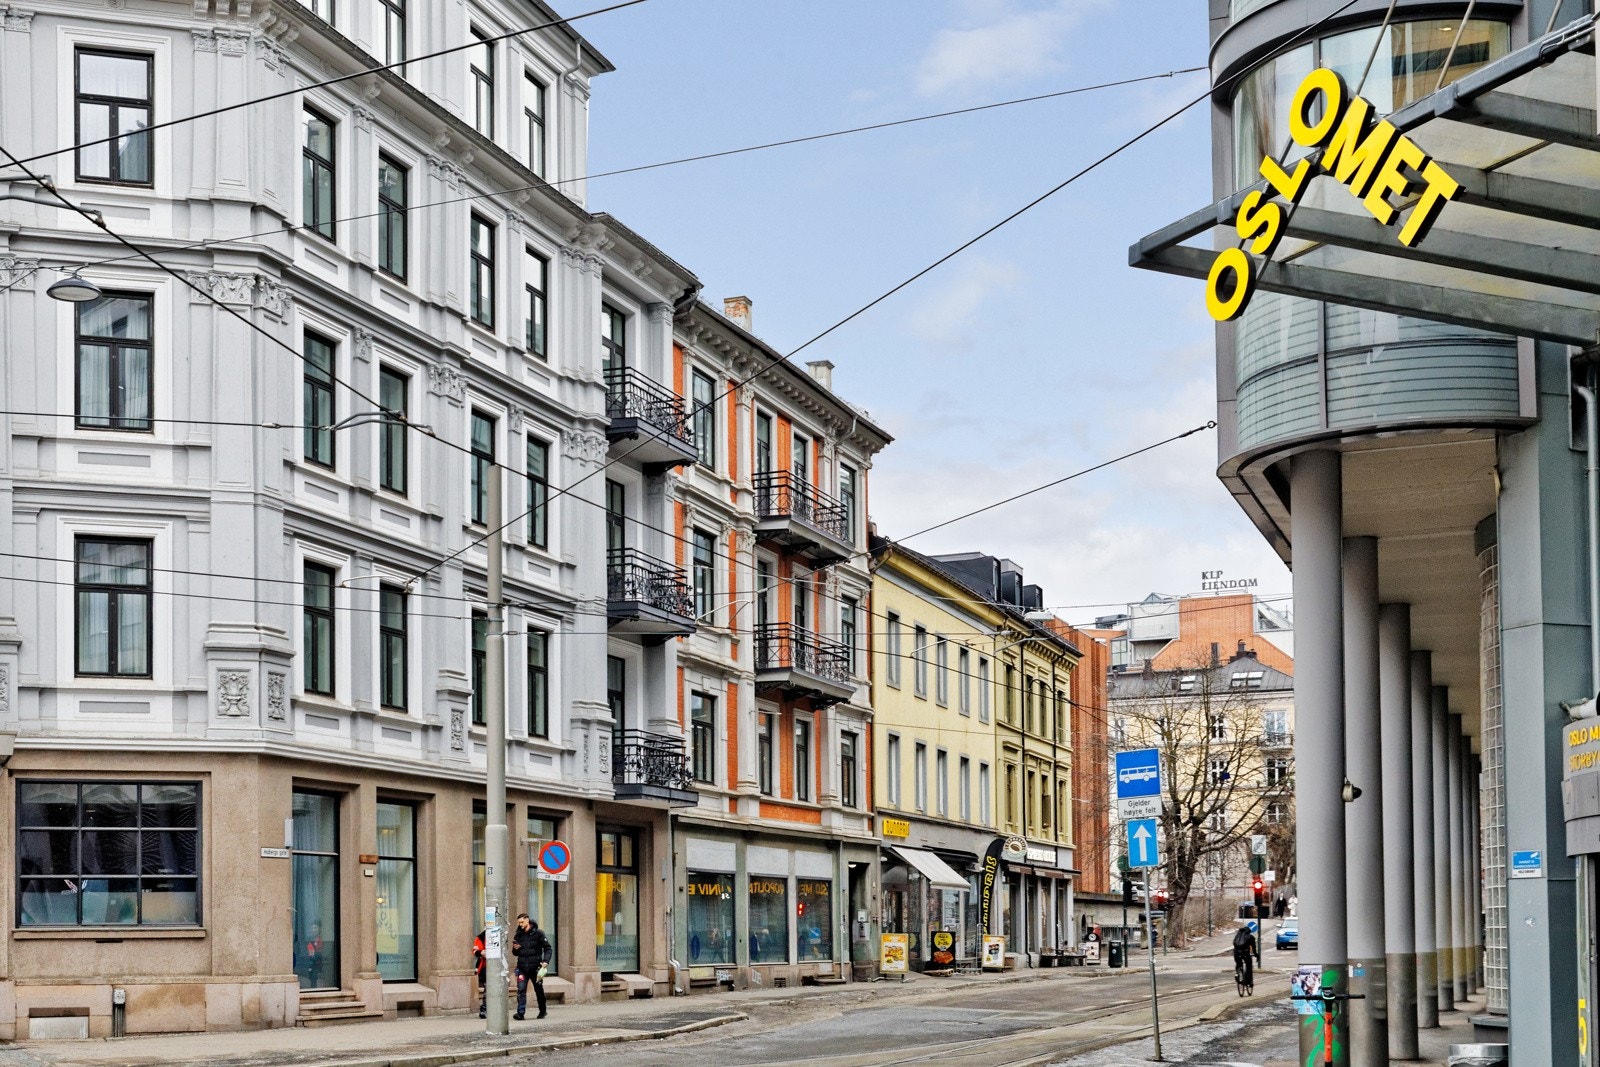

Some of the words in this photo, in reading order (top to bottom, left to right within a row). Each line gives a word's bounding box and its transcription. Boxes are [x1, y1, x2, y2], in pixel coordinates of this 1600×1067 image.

[1202, 570, 1223, 579] KLP
[1202, 578, 1258, 590] EIENDOM
[1569, 727, 1588, 747] OSLO
[1590, 724, 1600, 742] M
[1569, 750, 1600, 772] STORBY
[1128, 800, 1150, 808] Gjelder
